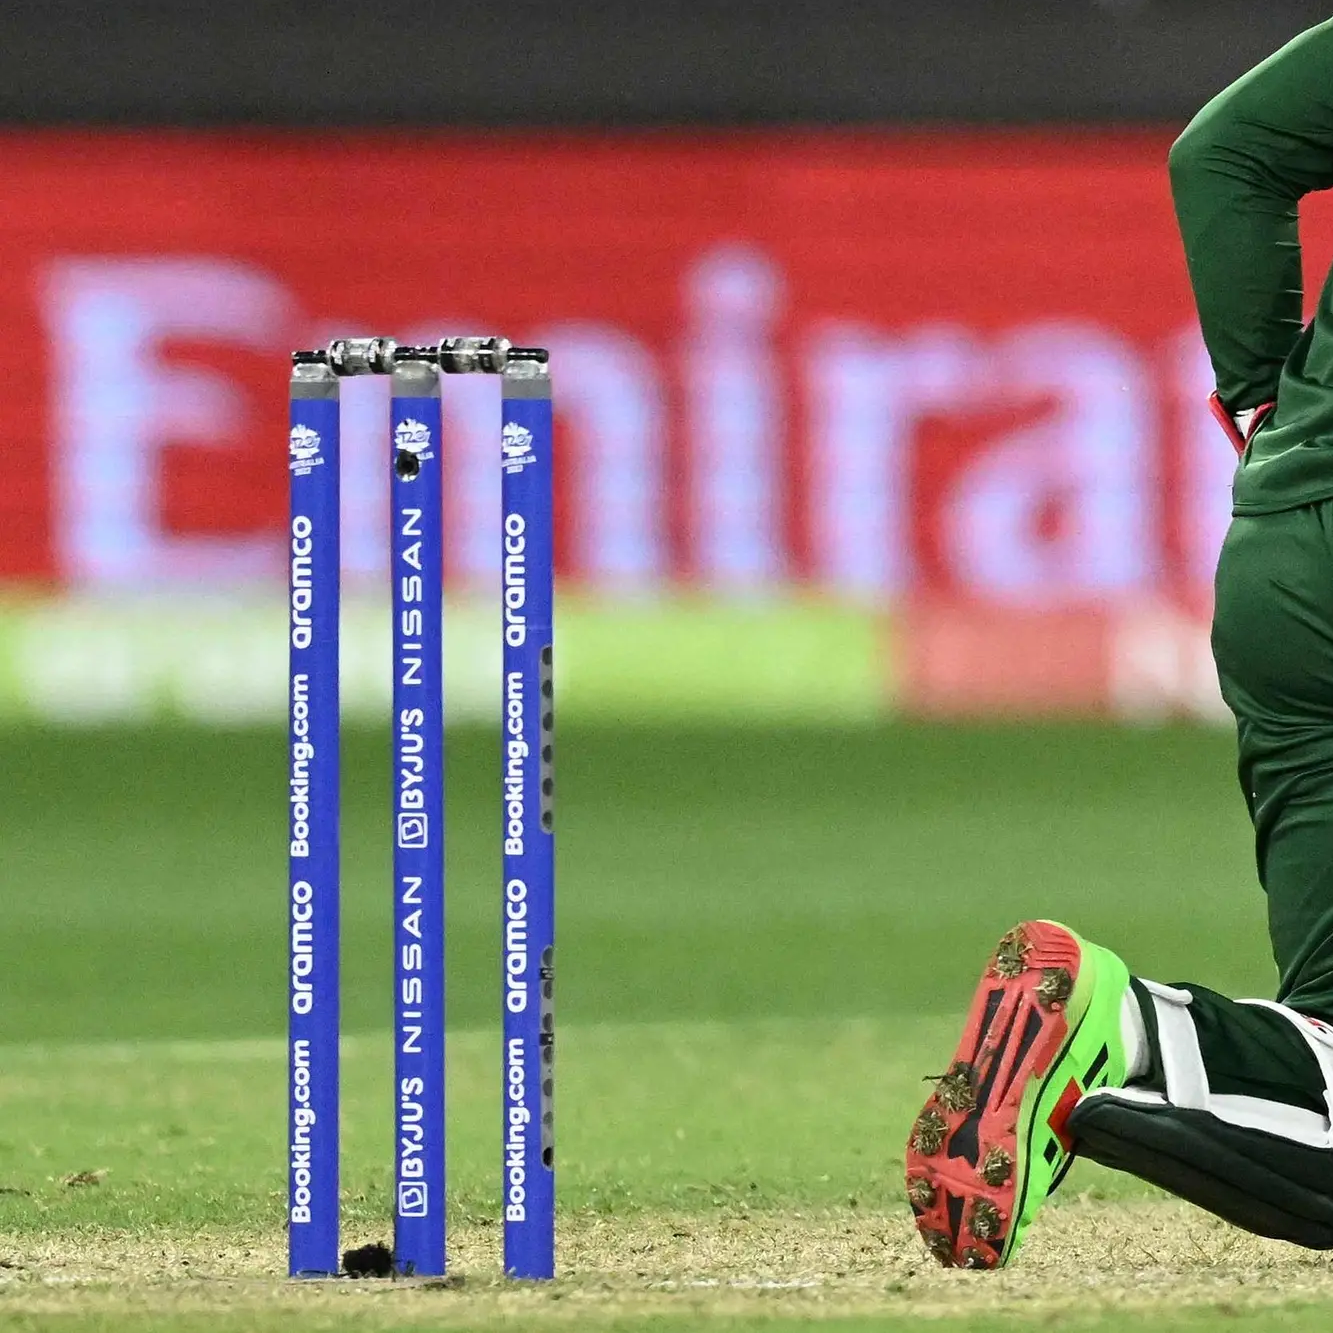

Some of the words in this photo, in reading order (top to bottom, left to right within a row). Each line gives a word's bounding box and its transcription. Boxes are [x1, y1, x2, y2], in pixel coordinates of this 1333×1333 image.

[291, 515, 313, 650] aramco
[402, 508, 422, 685] NISSAN
[504, 513, 527, 648] aramco
[290, 673, 315, 858] Booking.com
[401, 708, 423, 809] BYJU'S
[505, 671, 529, 856] Booking.com
[292, 880, 313, 1015] aramco
[403, 876, 422, 1053] NISSAN
[506, 878, 528, 1014] aramco
[290, 1039, 316, 1224] Booking.com
[402, 1077, 424, 1178] BYJU'S
[506, 1039, 530, 1223] Booking.com
